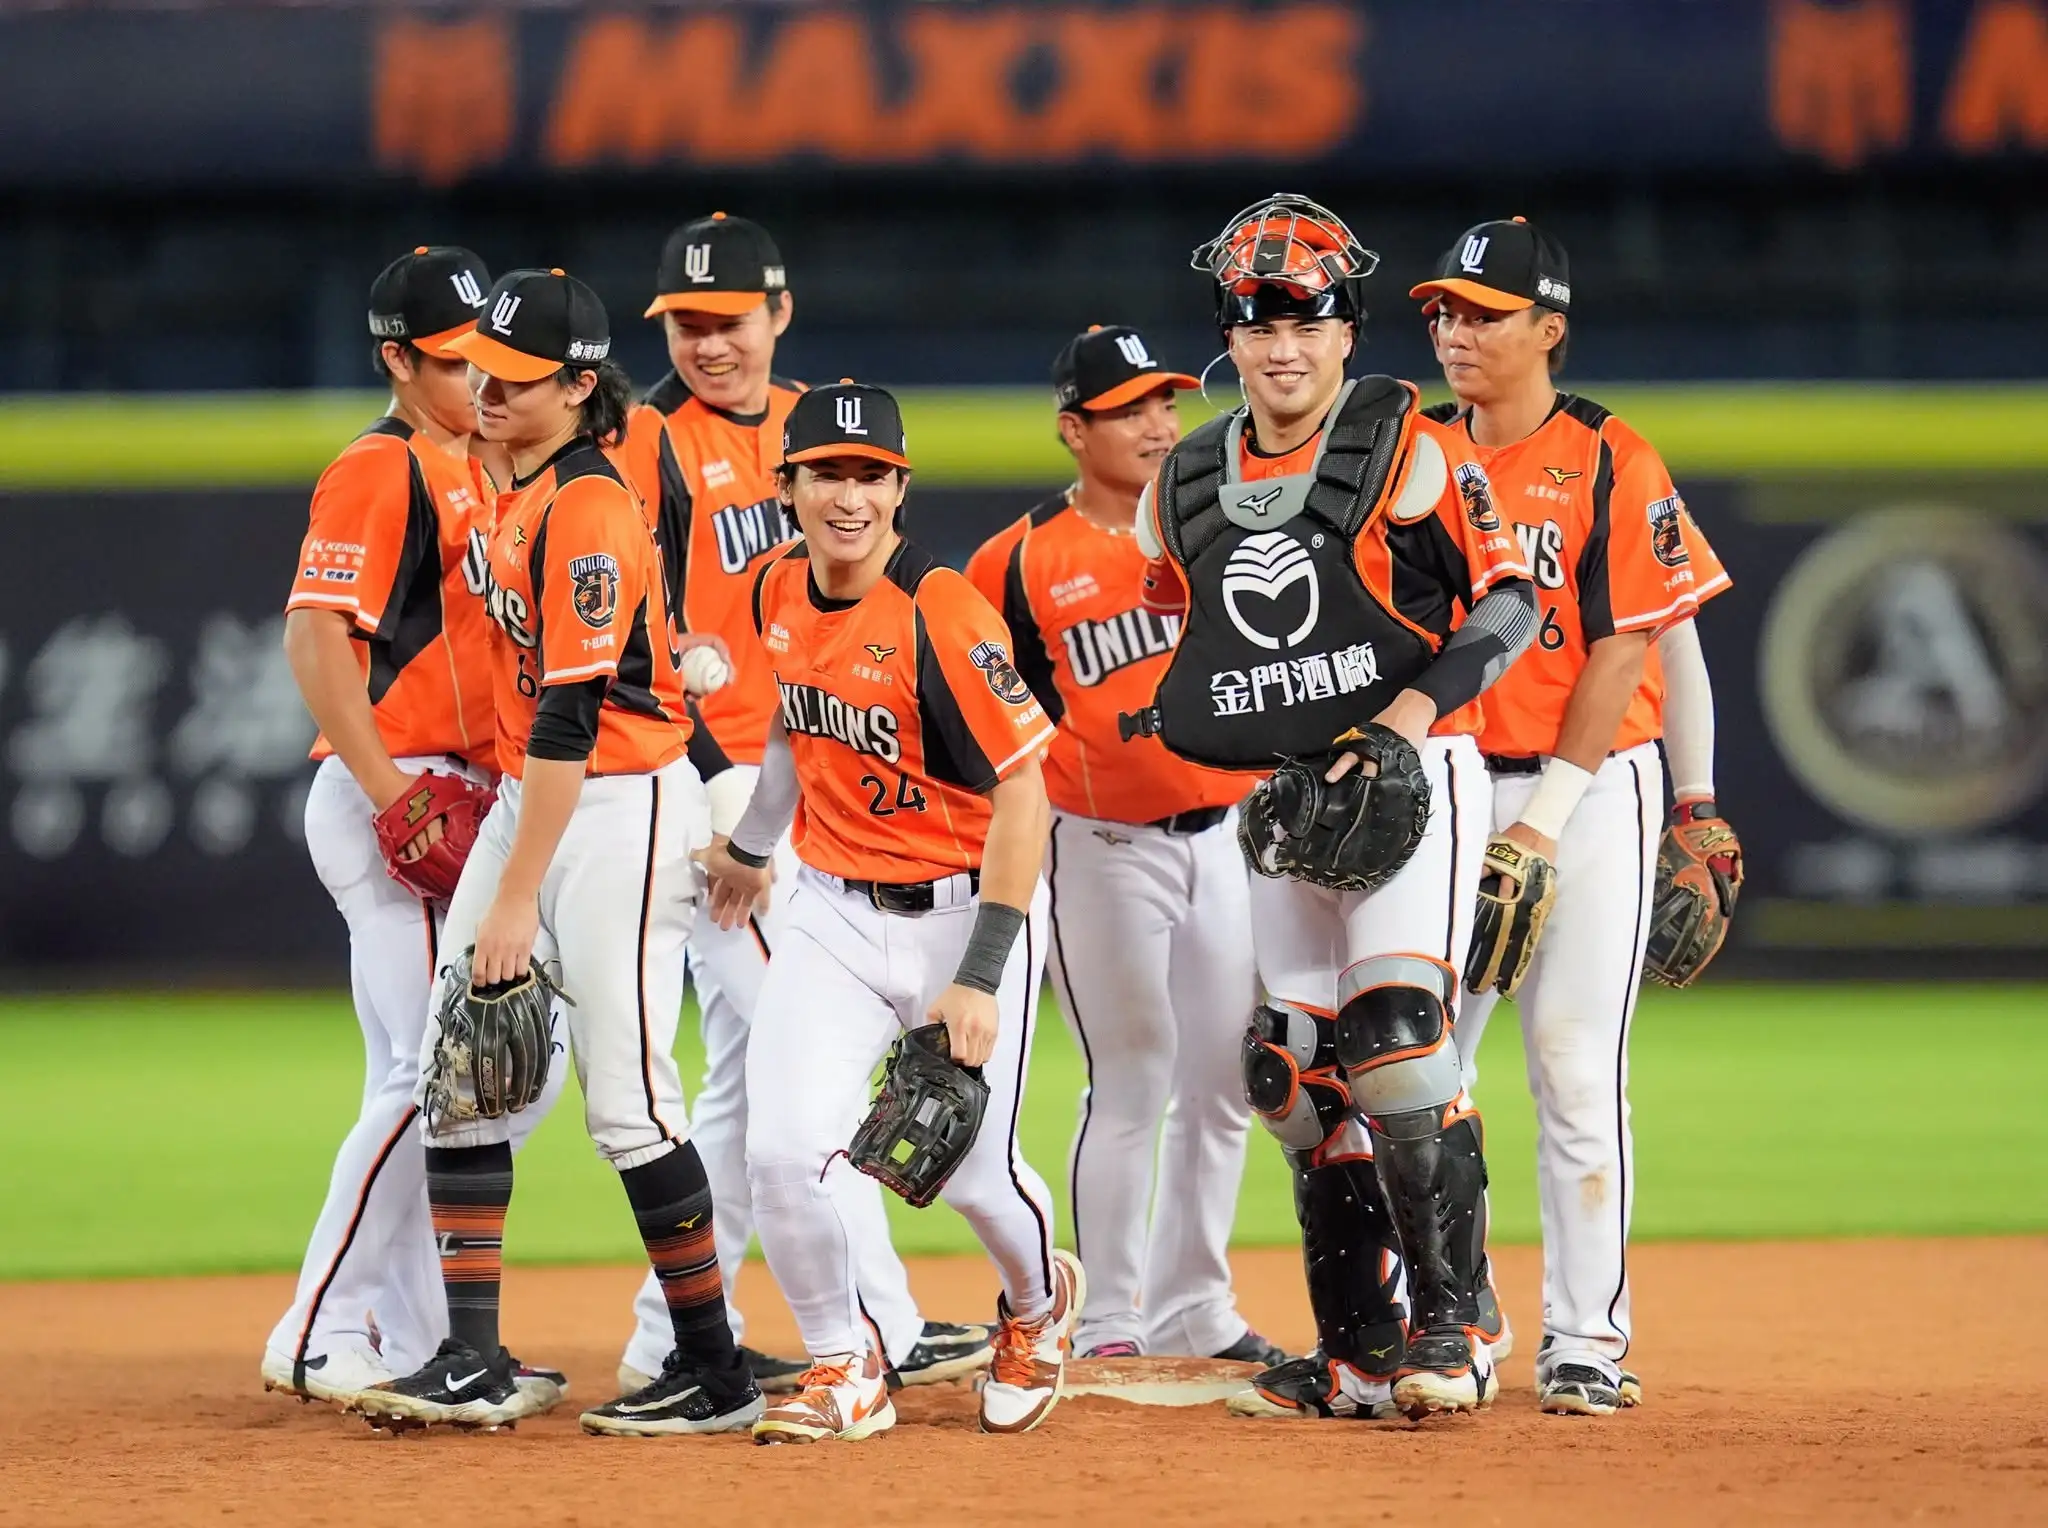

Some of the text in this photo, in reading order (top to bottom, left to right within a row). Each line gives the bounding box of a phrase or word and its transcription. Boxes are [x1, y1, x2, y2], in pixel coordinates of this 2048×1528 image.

[548, 8, 1362, 162] MAXXIS
[570, 556, 620, 580] UNILIONS
[1210, 642, 1383, 717] 金門酒廠
[774, 671, 901, 765] NILIONS
[860, 772, 926, 816] 24
